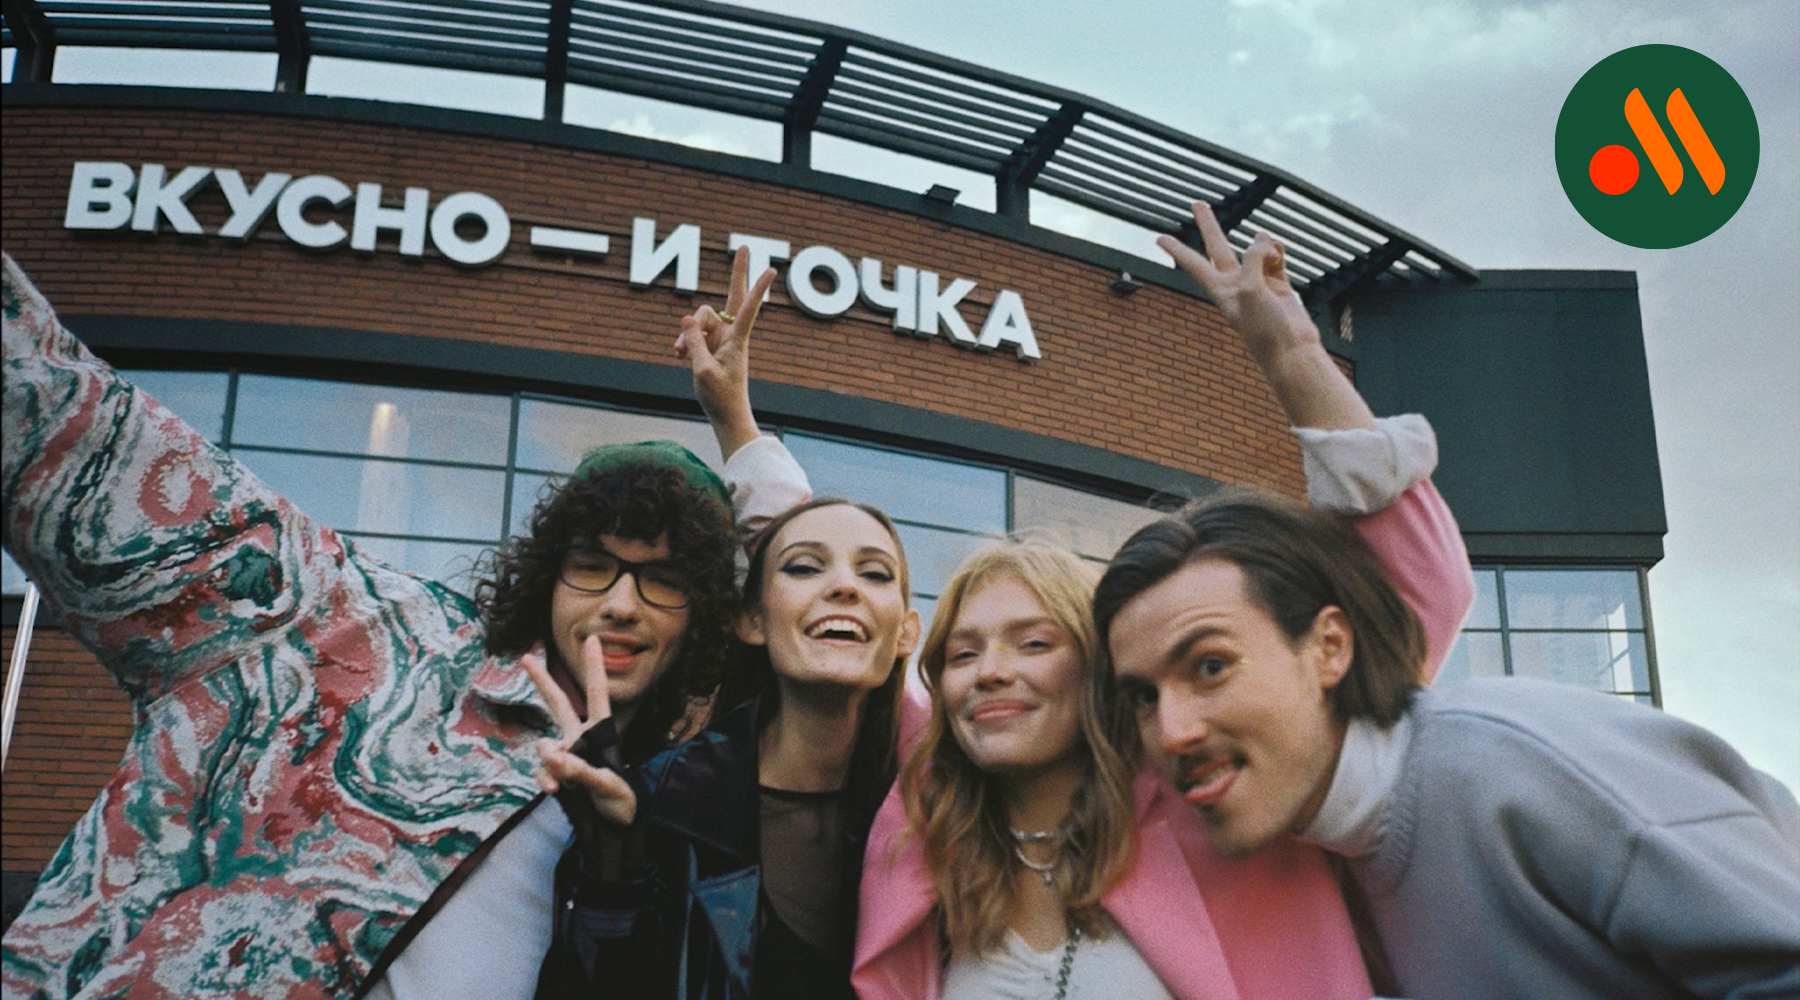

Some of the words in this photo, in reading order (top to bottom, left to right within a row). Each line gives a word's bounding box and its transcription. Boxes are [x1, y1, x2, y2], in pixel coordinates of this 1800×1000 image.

[64, 161, 511, 265] ВКУСНО
[629, 217, 701, 291] И
[728, 232, 1042, 361] ТОЧКА
